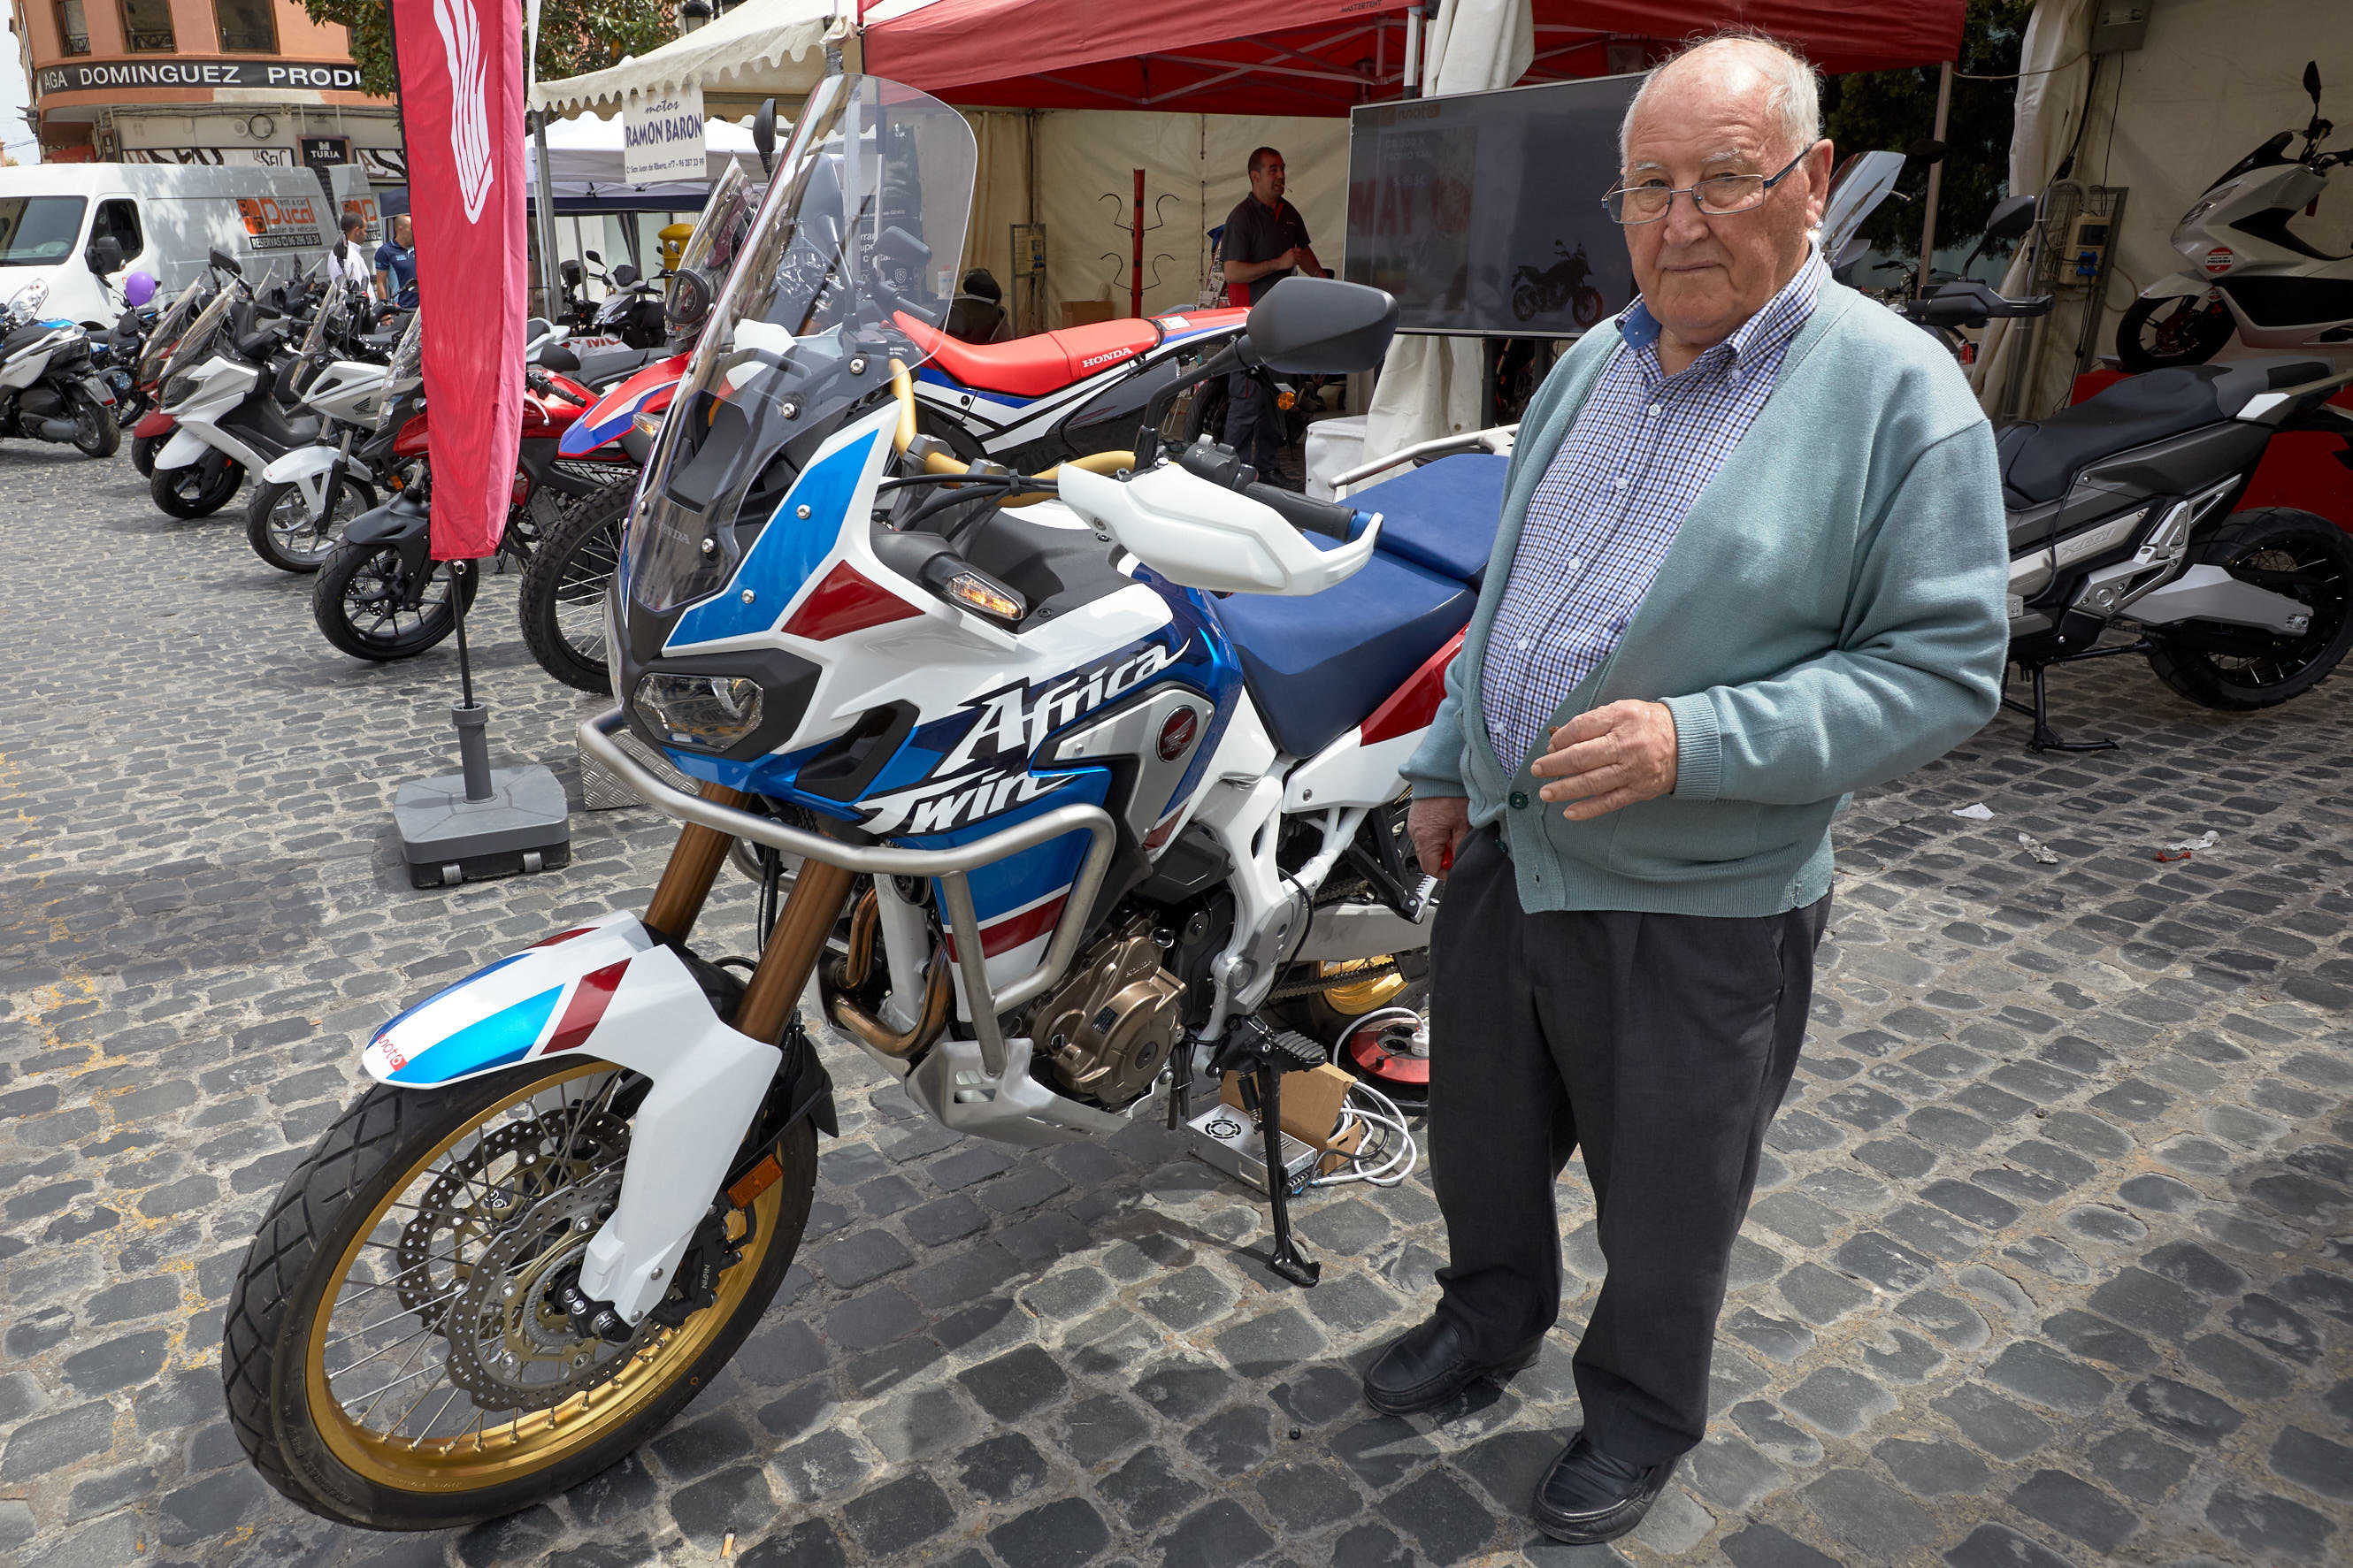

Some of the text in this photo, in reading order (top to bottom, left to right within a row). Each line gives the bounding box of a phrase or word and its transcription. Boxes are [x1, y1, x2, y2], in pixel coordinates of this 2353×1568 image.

[80, 65, 241, 86] DOMINGUEZ
[644, 99, 679, 113] motos
[625, 113, 702, 148] RAMON BARON
[310, 149, 341, 158] TURIA
[1083, 348, 1132, 368] HONDA
[931, 638, 1192, 779] Africa
[852, 766, 1077, 835] Twin
